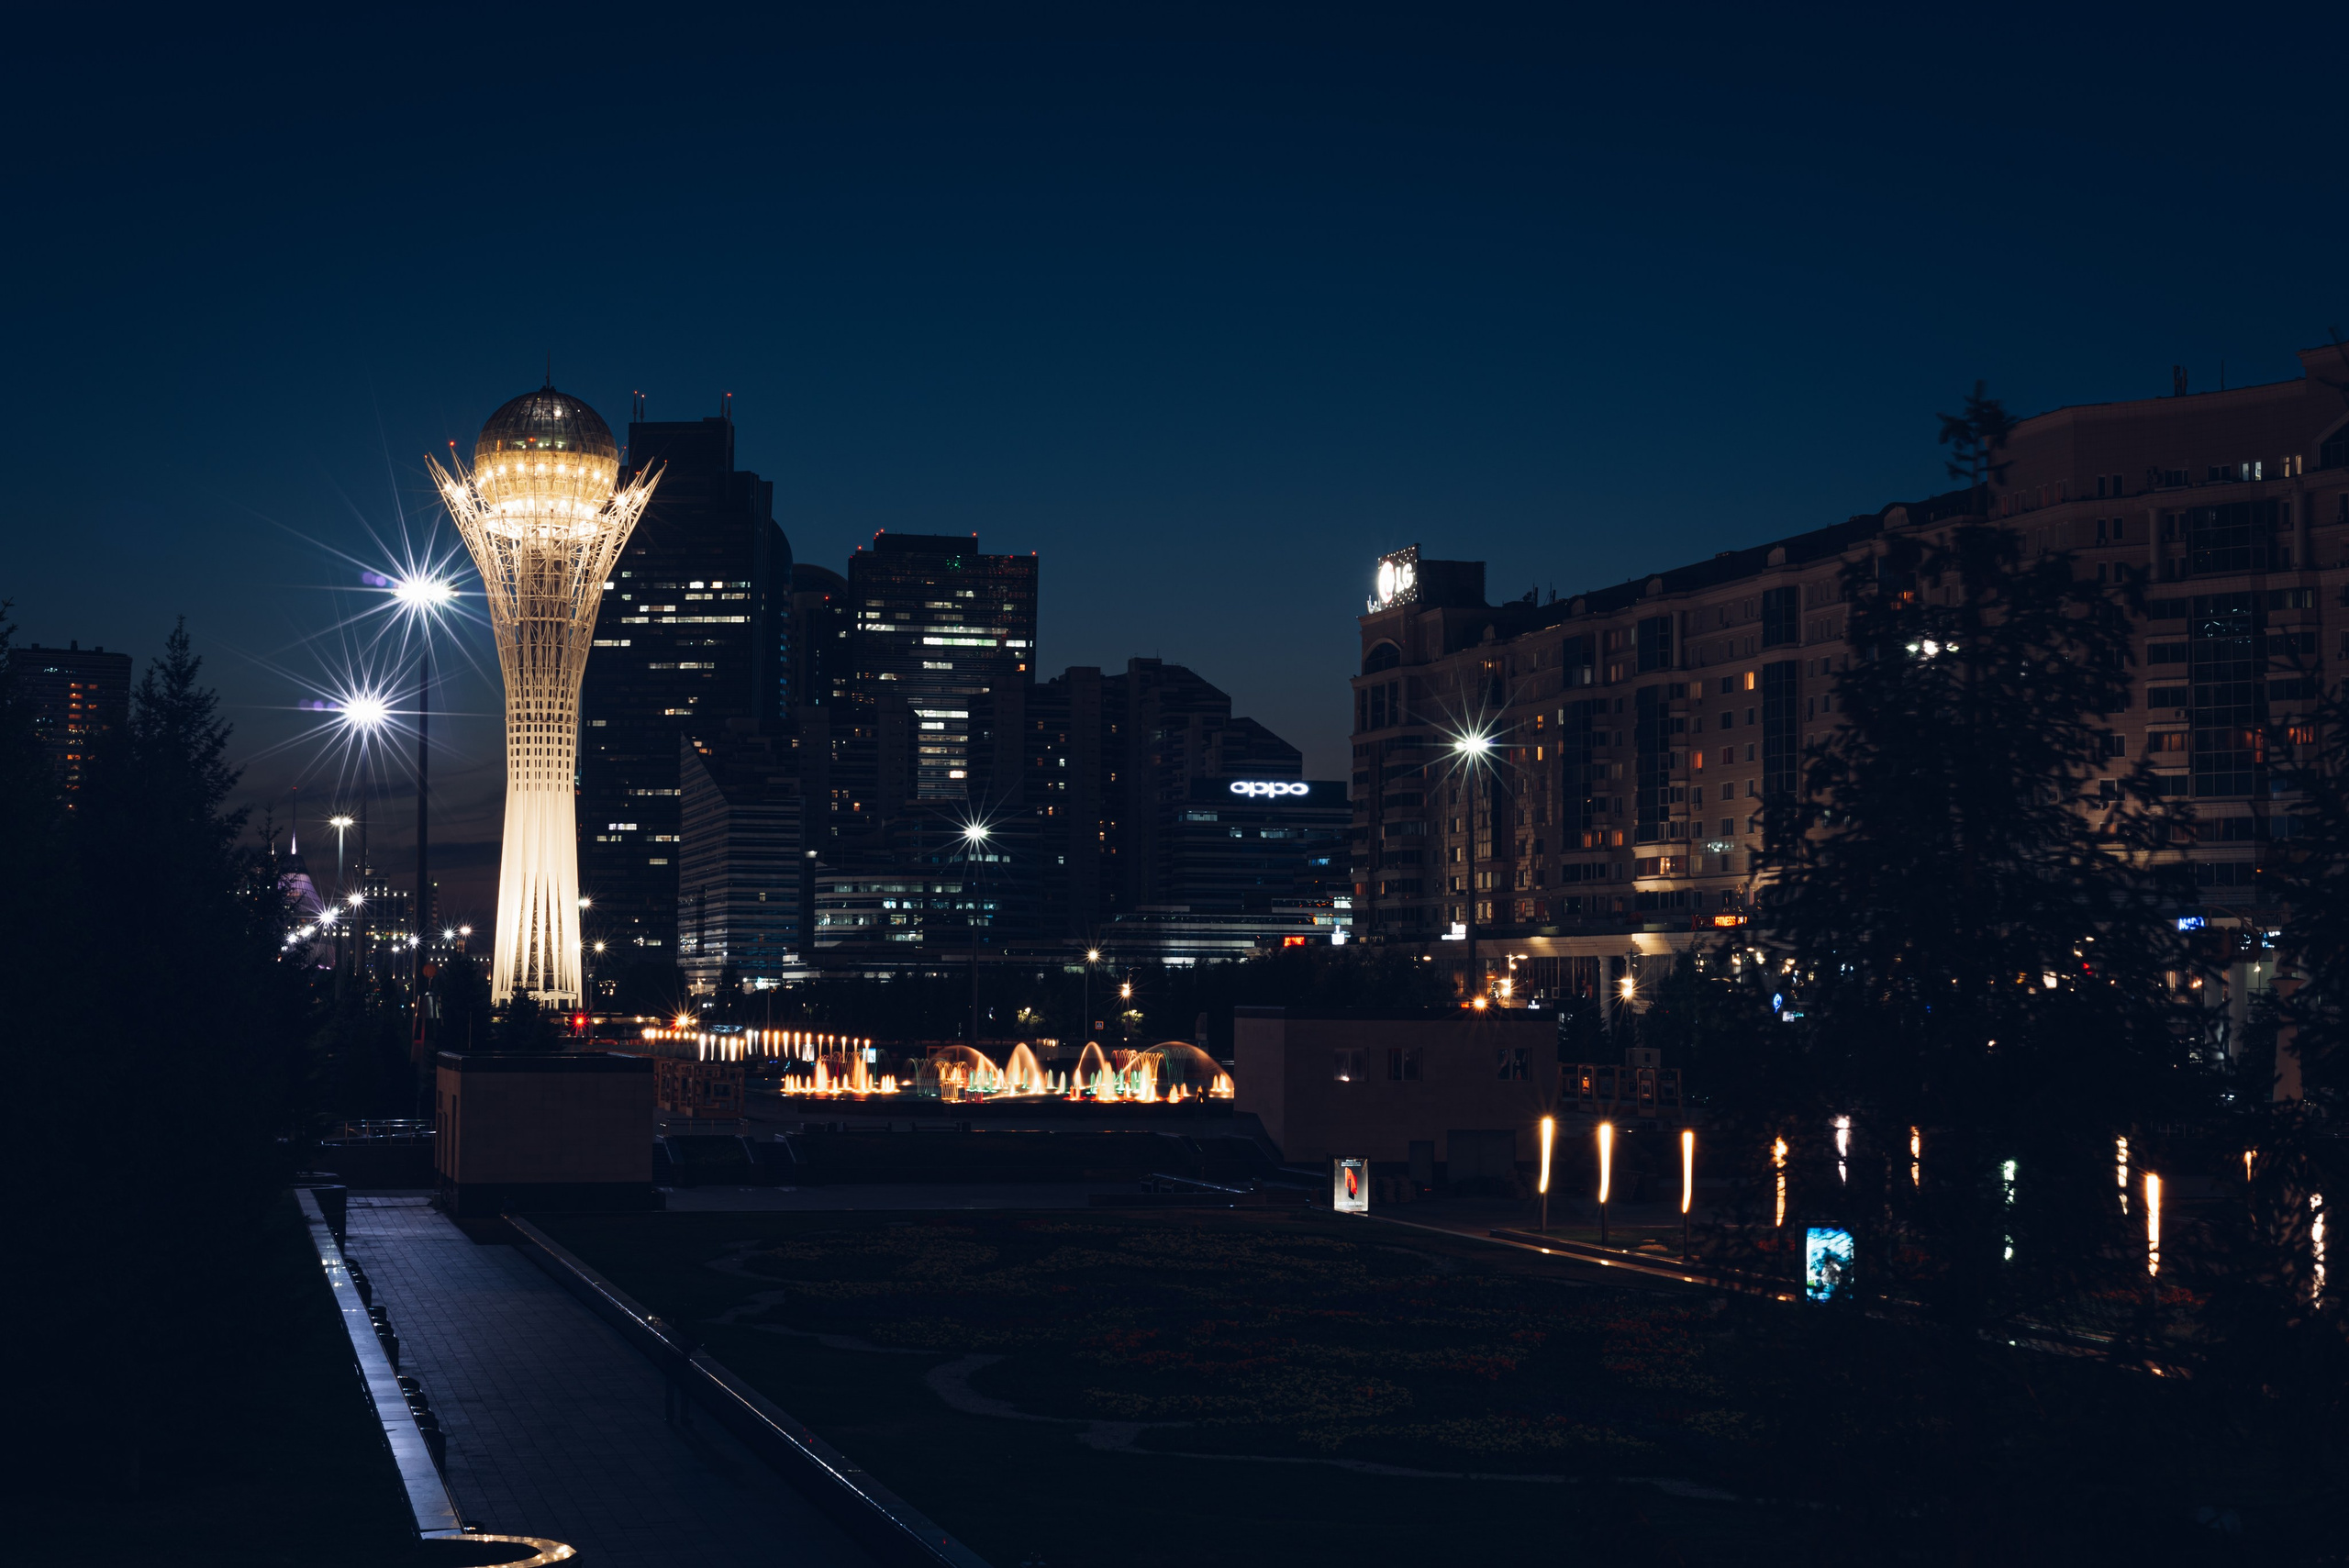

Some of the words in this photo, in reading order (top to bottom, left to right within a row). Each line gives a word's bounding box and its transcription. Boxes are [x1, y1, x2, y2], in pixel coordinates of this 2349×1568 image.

[1395, 562, 1414, 593] LG
[1230, 781, 1309, 798] oppo
[1714, 915, 1736, 927] FITNESS
